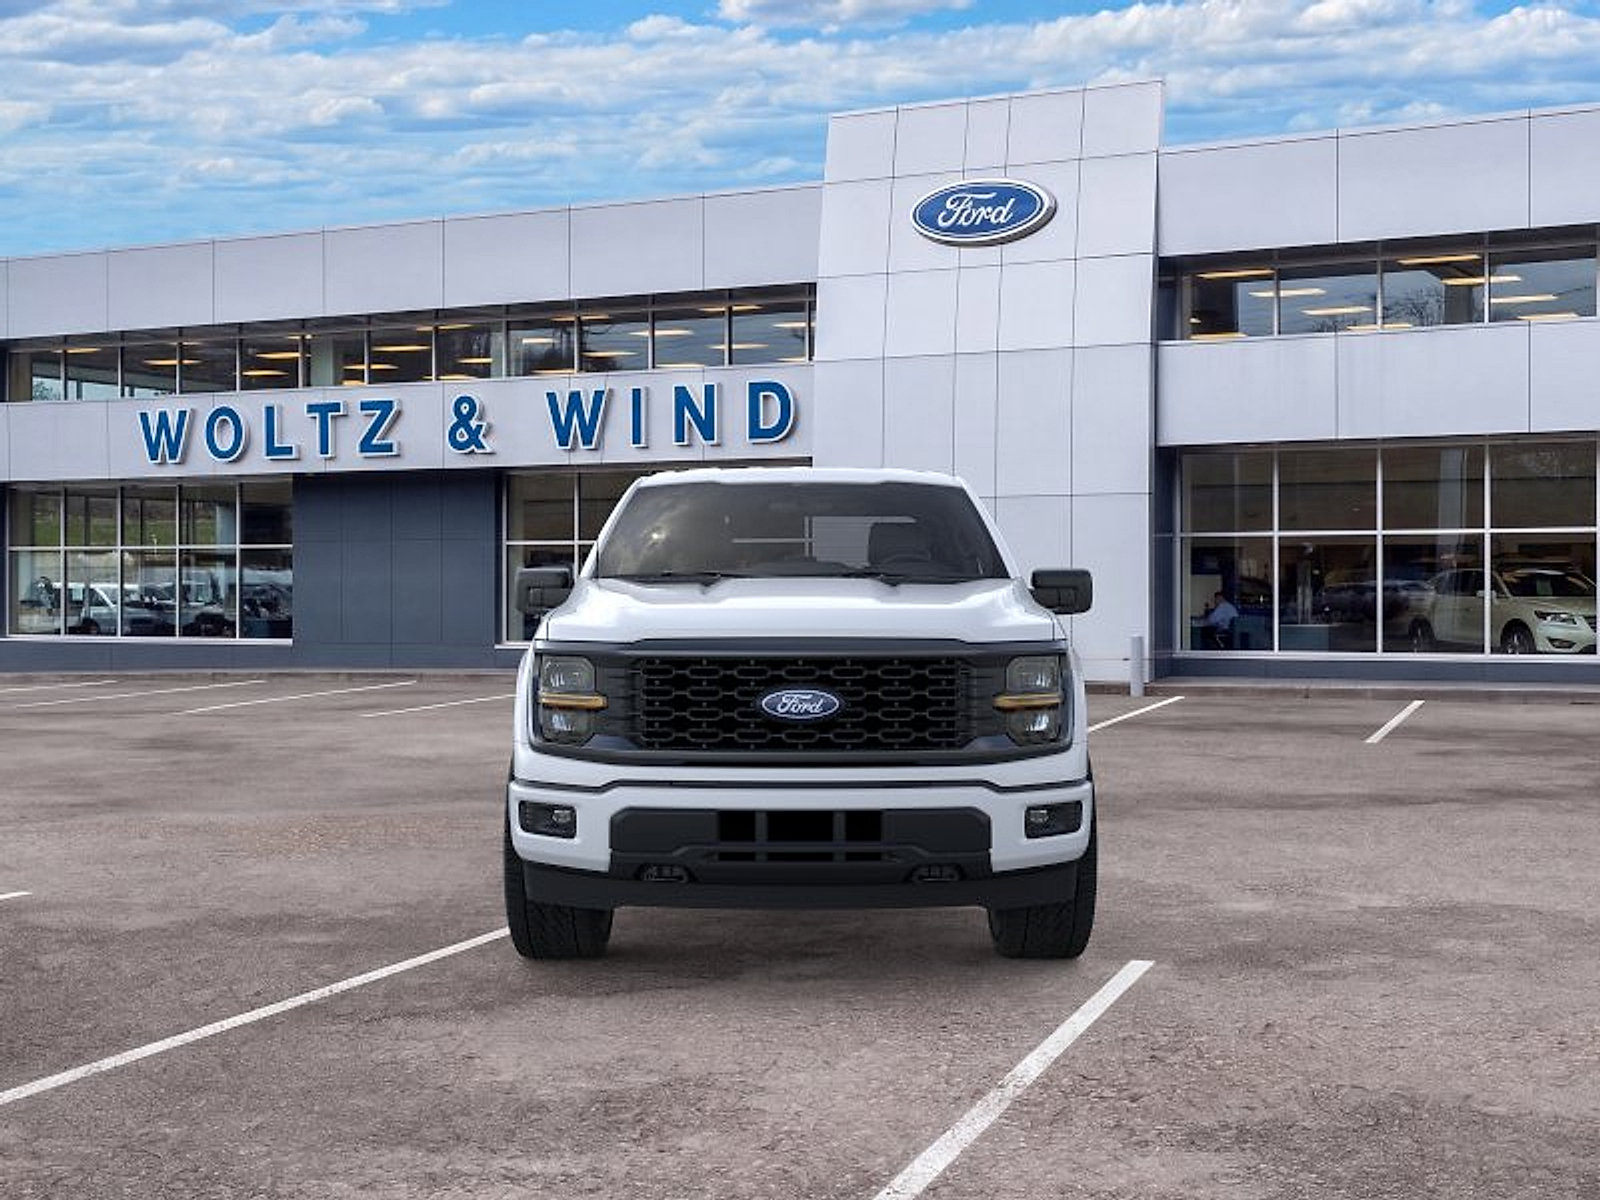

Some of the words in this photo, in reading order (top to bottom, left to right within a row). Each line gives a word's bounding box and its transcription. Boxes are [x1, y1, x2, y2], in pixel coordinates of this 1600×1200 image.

[938, 192, 1015, 228] Ford
[139, 399, 402, 464] WOLTZ
[446, 395, 493, 455] &
[546, 380, 796, 450] WIND
[777, 694, 825, 713] Ford
